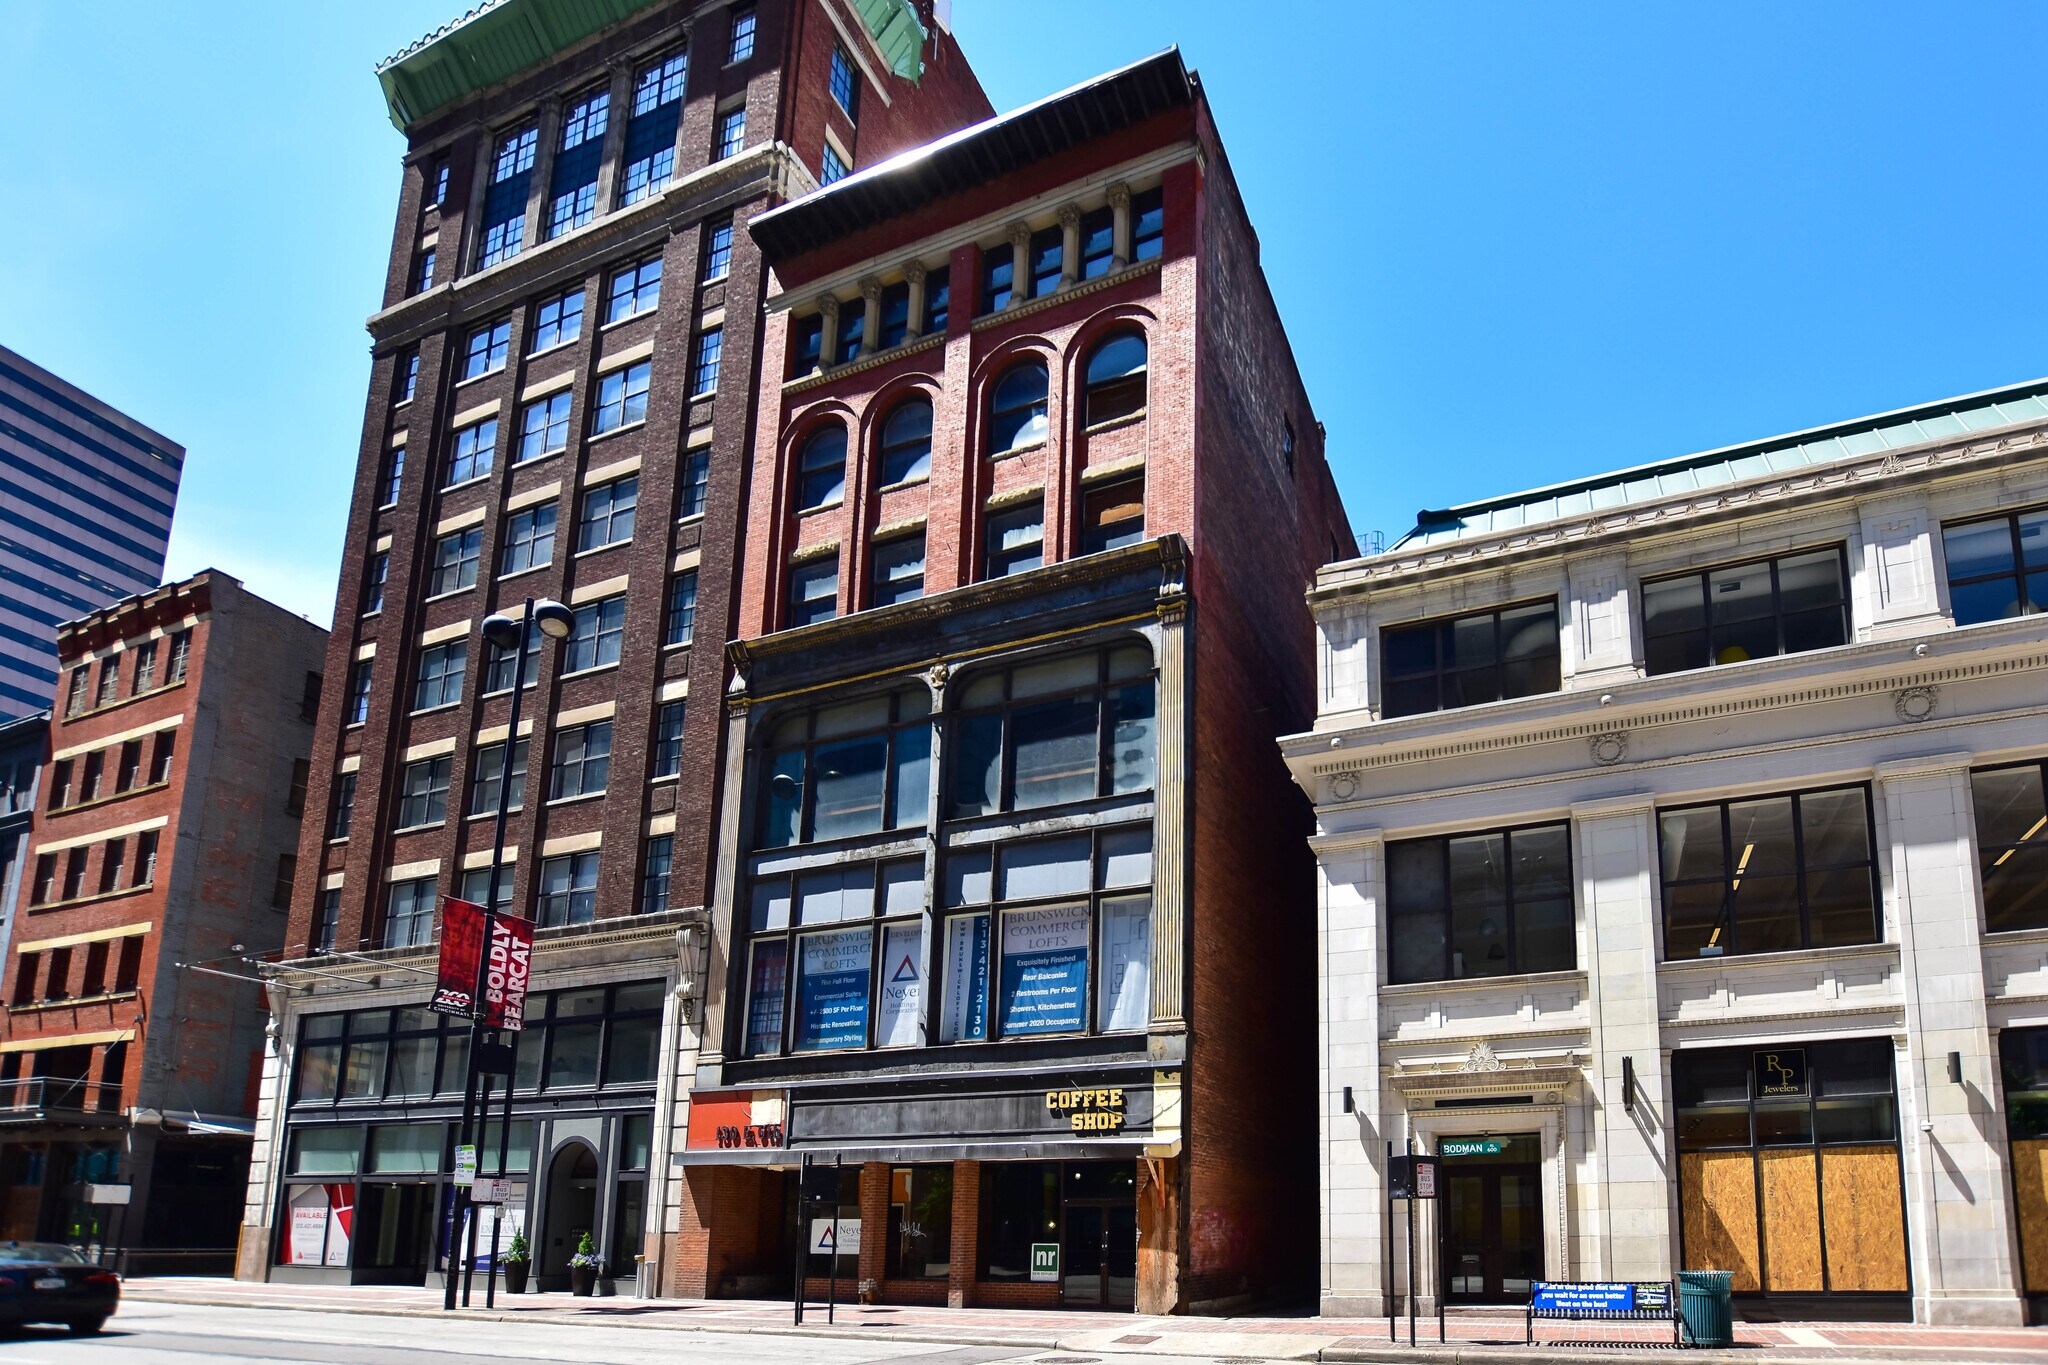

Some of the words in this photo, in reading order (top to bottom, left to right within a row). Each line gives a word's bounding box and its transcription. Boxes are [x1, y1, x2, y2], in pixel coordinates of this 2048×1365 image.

[1010, 906, 1089, 923] BRUNSWICK
[1010, 919, 1087, 936] COMMERCE
[1029, 936, 1068, 949] LOFTS
[486, 921, 511, 1003] BOLDLY
[824, 959, 857, 970] LOFTS
[1016, 957, 1050, 967] Exquisitely
[1050, 955, 1076, 963] Finished
[1038, 972, 1068, 980] Balconies
[503, 936, 530, 1031] BEARCAT
[814, 991, 844, 1000] Commercial
[1016, 989, 1048, 997] Restrooms
[1061, 986, 1078, 994] Floor
[850, 1004, 864, 1012] Floor
[1038, 1002, 1076, 1011] Kitchenettes
[832, 1020, 860, 1028] Renovation
[1046, 1018, 1080, 1026] Occupancy
[1764, 1085, 1798, 1093] Jewelers
[1046, 1088, 1123, 1109] COFFEE
[1071, 1112, 1123, 1130] SHOP
[1443, 1144, 1483, 1154] BODMAN
[1036, 1251, 1056, 1266] nr
[1578, 1284, 1594, 1292] good
[1542, 1292, 1554, 1300] you
[1604, 1292, 1625, 1300] better
